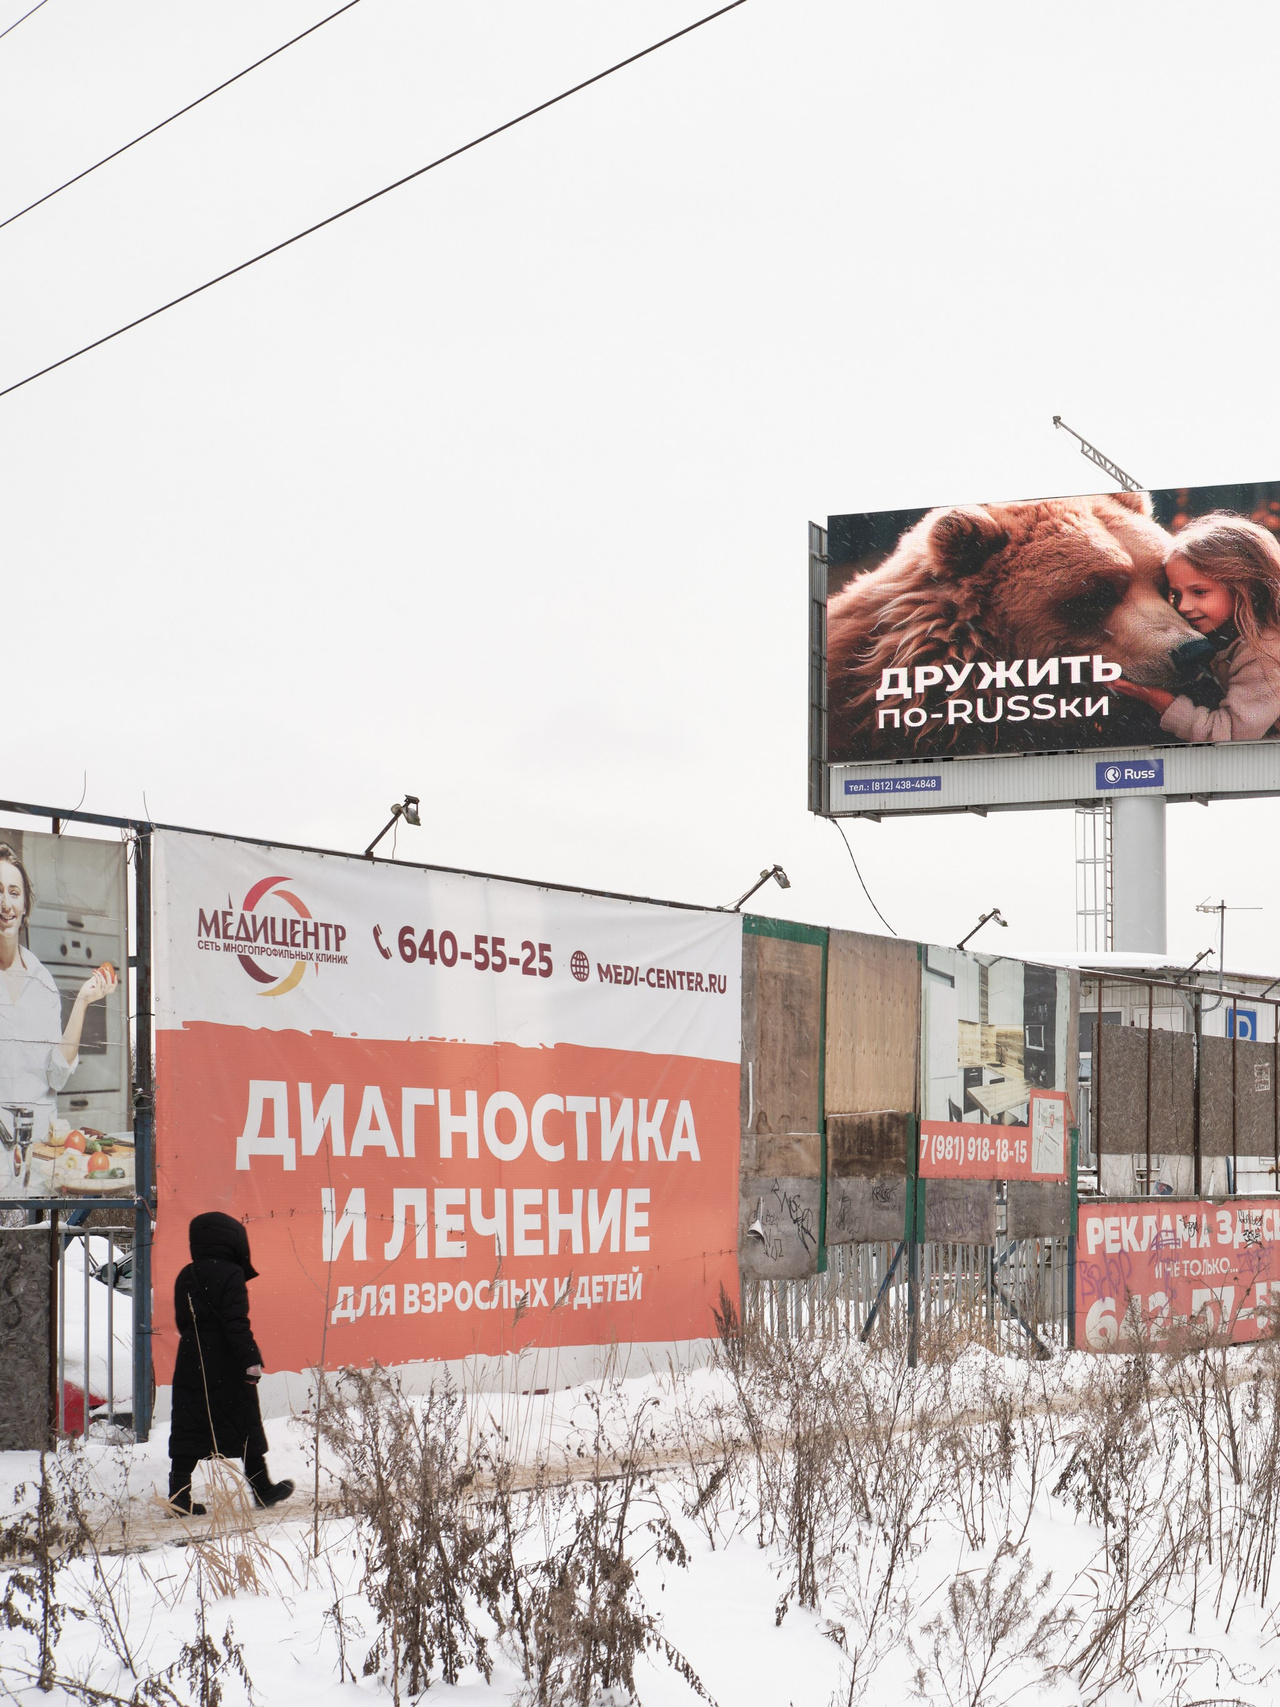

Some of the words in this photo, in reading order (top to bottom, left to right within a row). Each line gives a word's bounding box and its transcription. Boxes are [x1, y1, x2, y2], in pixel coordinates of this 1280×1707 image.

[876, 655, 1122, 700] ДРУЖИТЬ
[878, 694, 1109, 729] по-RUSSки
[871, 780, 893, 792] (812)
[895, 779, 936, 790] 438-4848
[1124, 768, 1155, 780] Russ
[197, 905, 346, 952] МЕДИЦЕНТР
[197, 940, 221, 952] СЕТЬ
[223, 942, 314, 961] МНОГОПРОФИЛЬНЫХ
[315, 952, 348, 965] КЛИНИК
[398, 925, 553, 978] 640-55-25
[597, 962, 727, 994] MEDI-CENTER.RU
[235, 1080, 700, 1171] ДИАГНОСТИКА
[931, 1135, 964, 1165] (981)
[967, 1137, 1027, 1164] 918-18-15
[321, 1188, 367, 1262] И
[384, 1188, 650, 1259] ЛЕЧЕНИЕ
[1086, 1213, 1211, 1254] РЕКЛАМА
[1165, 1261, 1180, 1277] НЕ
[331, 1284, 396, 1324] ДЛЯ
[404, 1276, 548, 1315] ВЗРОСЛЫХ
[573, 1265, 643, 1310] ДЕТЕЙ
